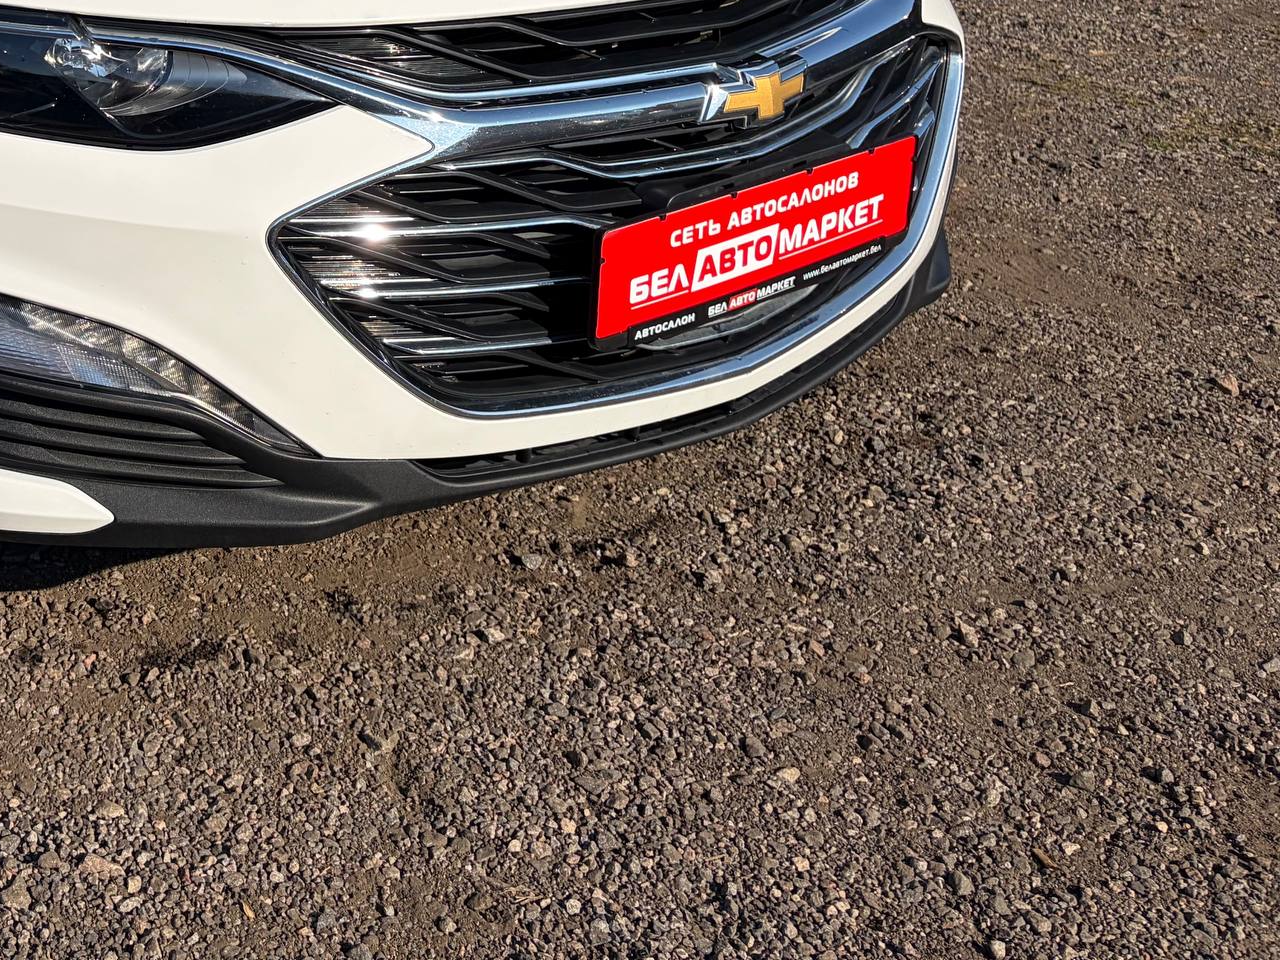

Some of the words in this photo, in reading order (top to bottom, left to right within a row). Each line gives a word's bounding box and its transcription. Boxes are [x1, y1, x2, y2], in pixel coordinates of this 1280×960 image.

[670, 219, 721, 248] СЕТЬ
[727, 171, 859, 231] АВТОСАЛОНОВ
[634, 312, 696, 341] АВТОСАЛОН
[802, 244, 882, 281] www.белавтомаркет.бел
